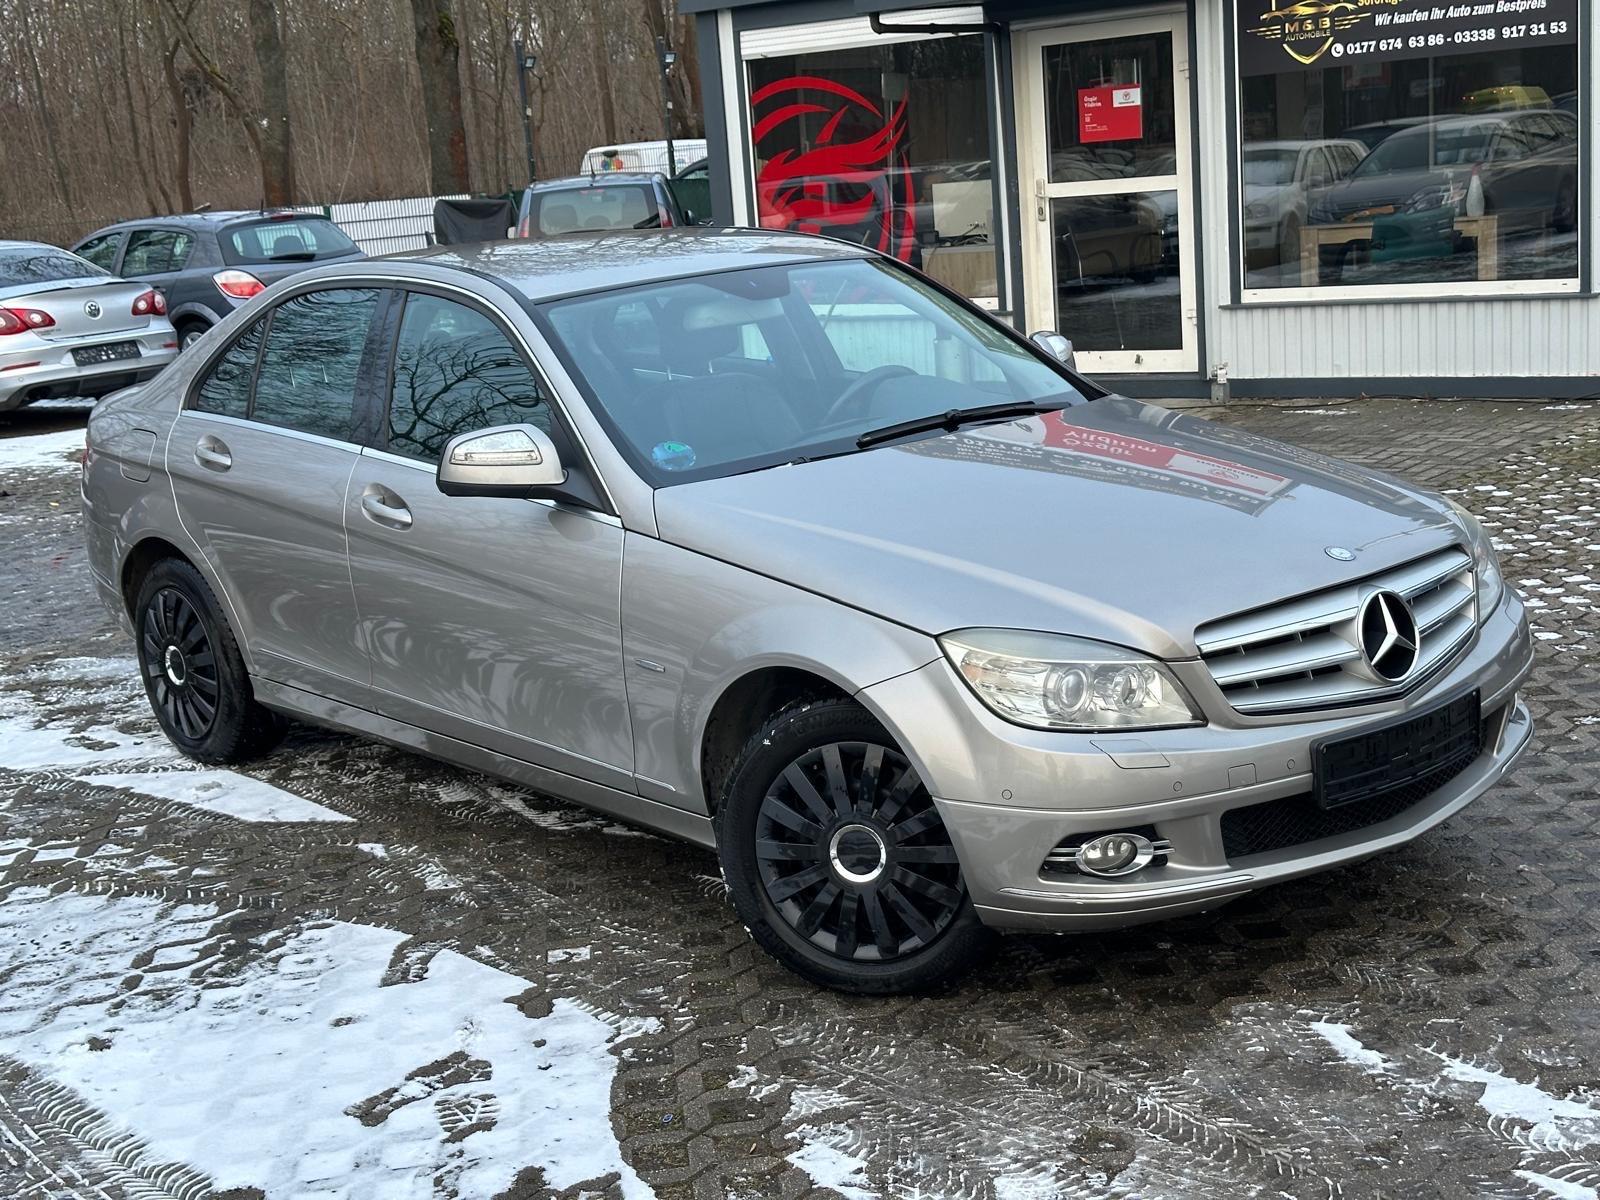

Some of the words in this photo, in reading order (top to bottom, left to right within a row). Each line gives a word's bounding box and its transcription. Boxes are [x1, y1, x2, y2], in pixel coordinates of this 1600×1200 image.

[1375, 12, 1392, 26] Wir
[1393, 9, 1429, 24] kaufen
[1446, 4, 1471, 19] Auto
[1472, 4, 1495, 16] zum
[1495, 0, 1547, 13] Bestpreis
[1284, 29, 1331, 41] AUTOMOBILE
[1285, 21, 1299, 34] M
[1318, 17, 1331, 29] B
[1346, 41, 1376, 55] 0177
[1378, 39, 1403, 51] 674
[1408, 35, 1425, 48] 63
[1427, 33, 1444, 46] 86
[1454, 28, 1496, 43] 03338
[1501, 25, 1526, 39] 917
[1529, 22, 1547, 36] 31
[1549, 21, 1568, 34] 53
